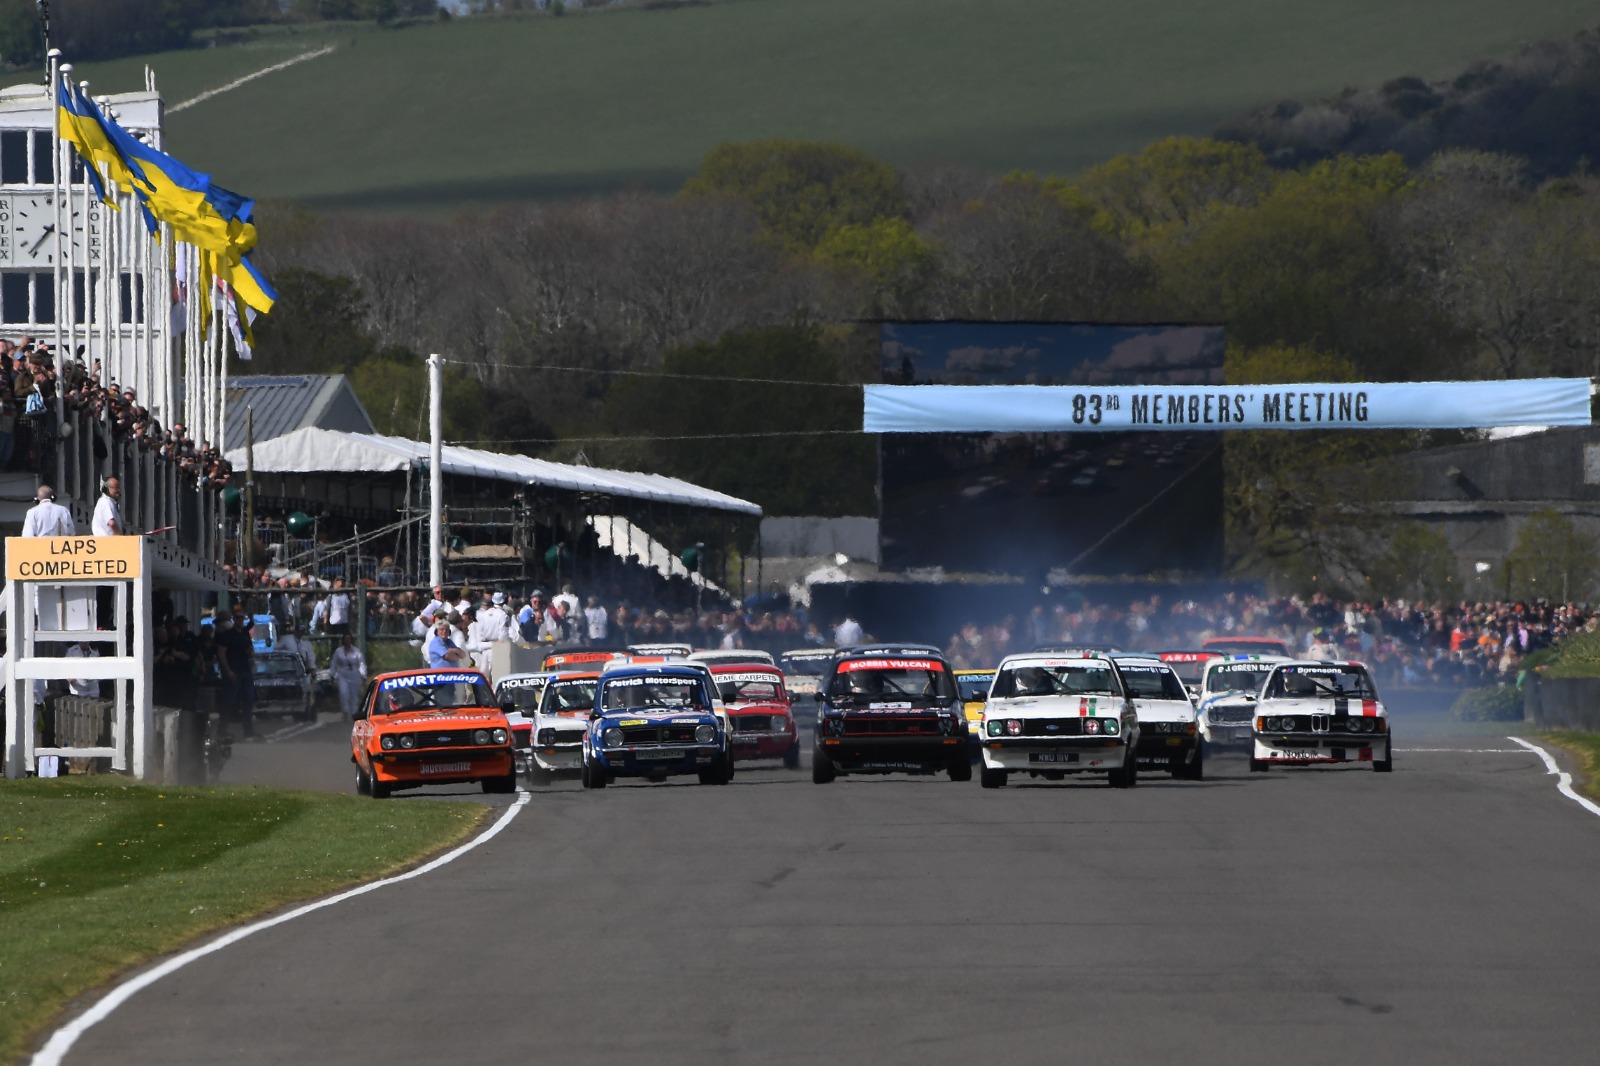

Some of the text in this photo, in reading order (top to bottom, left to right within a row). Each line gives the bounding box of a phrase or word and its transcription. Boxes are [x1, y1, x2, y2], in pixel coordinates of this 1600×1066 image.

[0, 200, 9, 259] ROLEX
[90, 200, 101, 259] ROLEX
[1131, 394, 1254, 424] MEMBERS'
[1263, 392, 1368, 423] MEETING
[50, 540, 97, 554] LAPS
[20, 560, 127, 576] COMPLETED
[849, 661, 930, 669] MORRIS VULCAN
[1165, 654, 1197, 662] AKAI
[1231, 664, 1258, 672] GREEN
[384, 674, 437, 690] HWRT
[501, 678, 545, 689] HOLDEN
